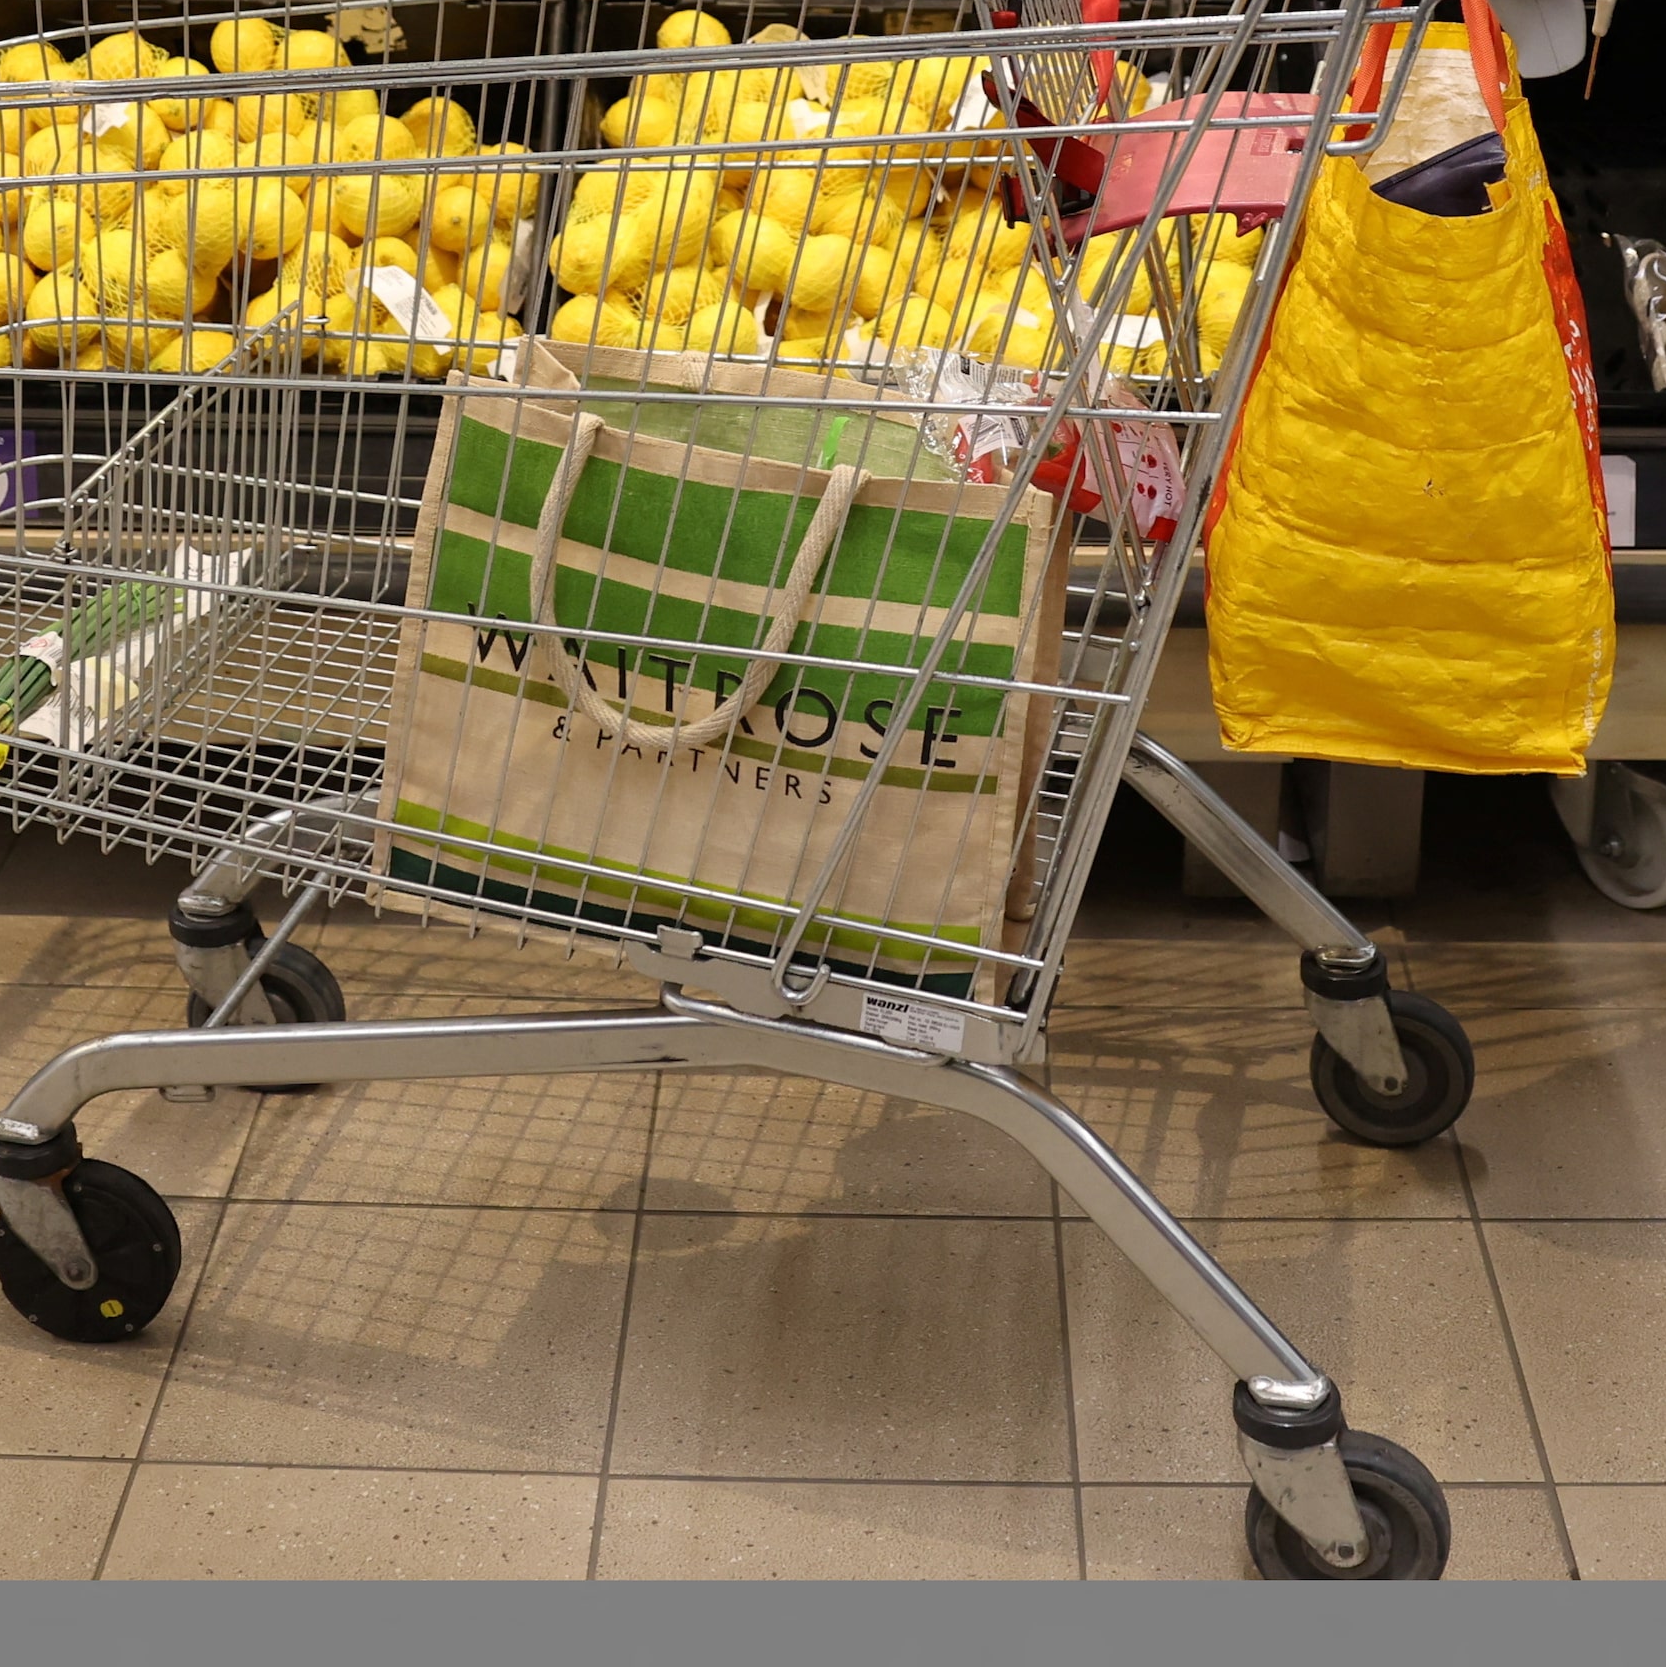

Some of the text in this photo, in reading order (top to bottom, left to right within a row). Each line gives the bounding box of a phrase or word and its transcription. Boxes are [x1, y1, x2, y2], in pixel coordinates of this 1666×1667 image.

[1164, 487, 1174, 507] HOT
[467, 601, 963, 768] WAITROSE
[866, 996, 910, 1014] wanzl
